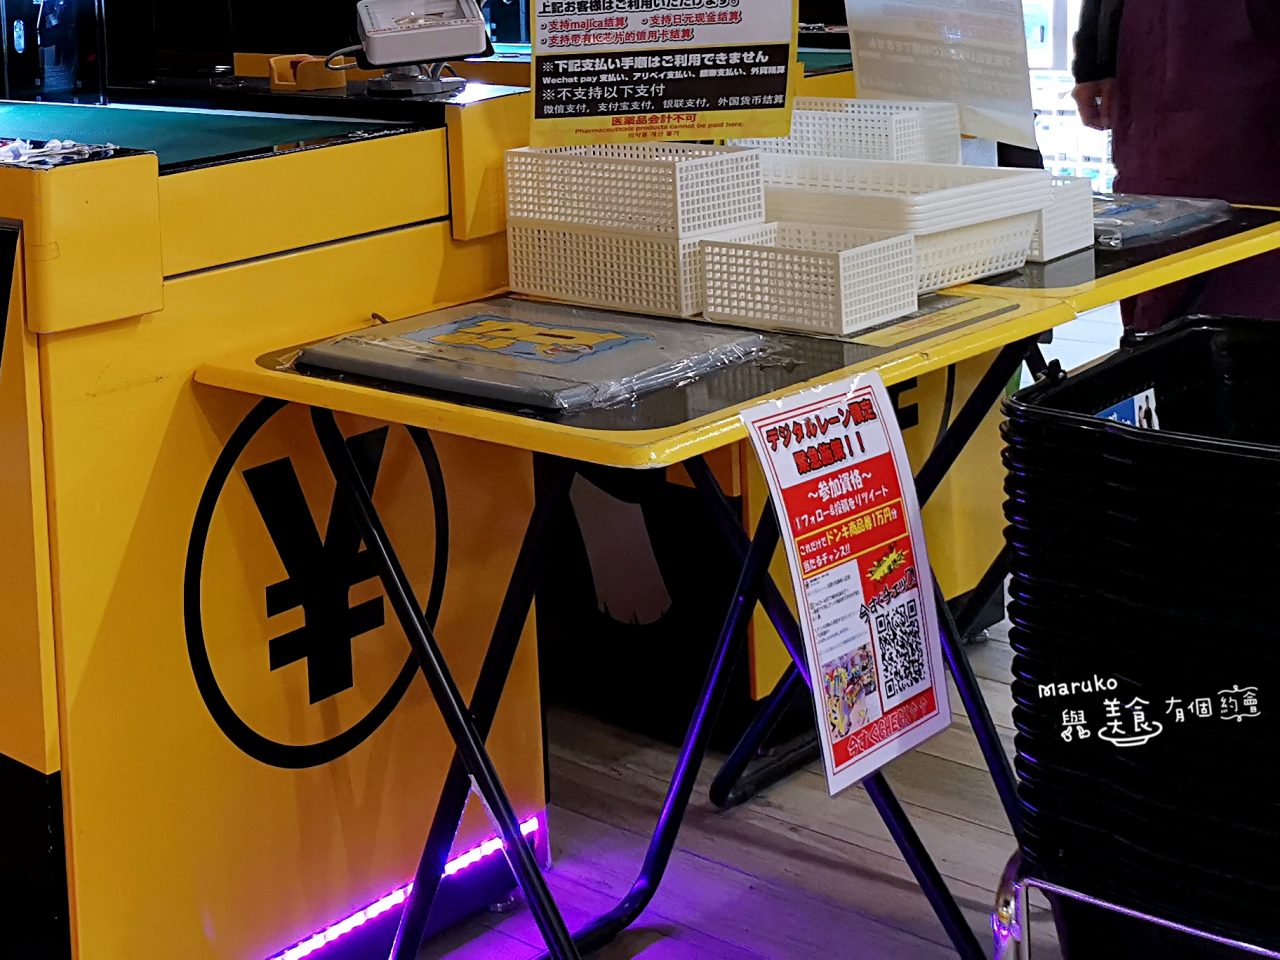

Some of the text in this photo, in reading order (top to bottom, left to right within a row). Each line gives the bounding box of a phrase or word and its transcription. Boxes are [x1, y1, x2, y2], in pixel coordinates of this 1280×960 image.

[542, 82, 666, 102] ※不支持以下支付
[610, 113, 698, 127] 医薬品会計不可
[636, 123, 668, 133] products
[669, 122, 695, 131] cannot
[696, 122, 706, 130] be
[706, 121, 724, 131] paid
[725, 120, 745, 130] here.
